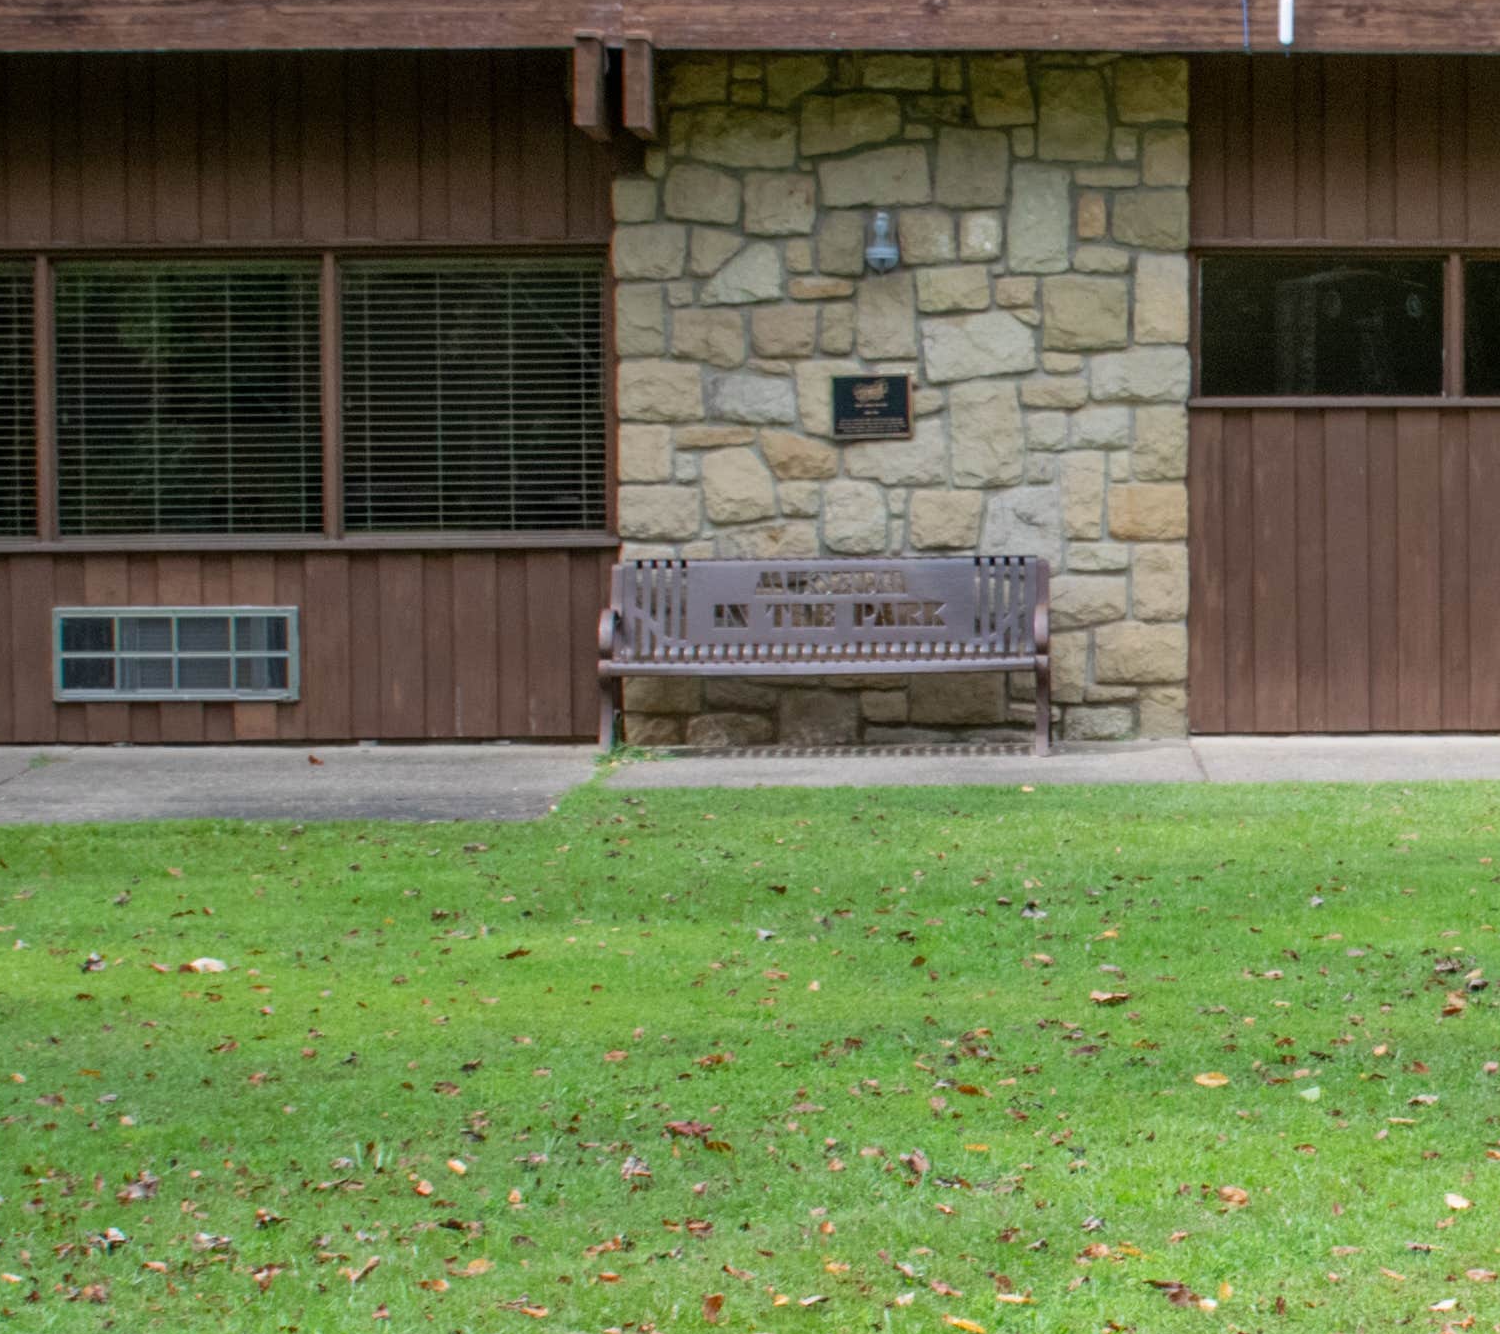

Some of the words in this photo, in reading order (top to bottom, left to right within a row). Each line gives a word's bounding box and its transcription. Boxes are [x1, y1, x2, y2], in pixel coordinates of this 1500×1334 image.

[713, 603, 749, 628] IN
[765, 603, 837, 628] THE
[852, 603, 948, 629] PARK
